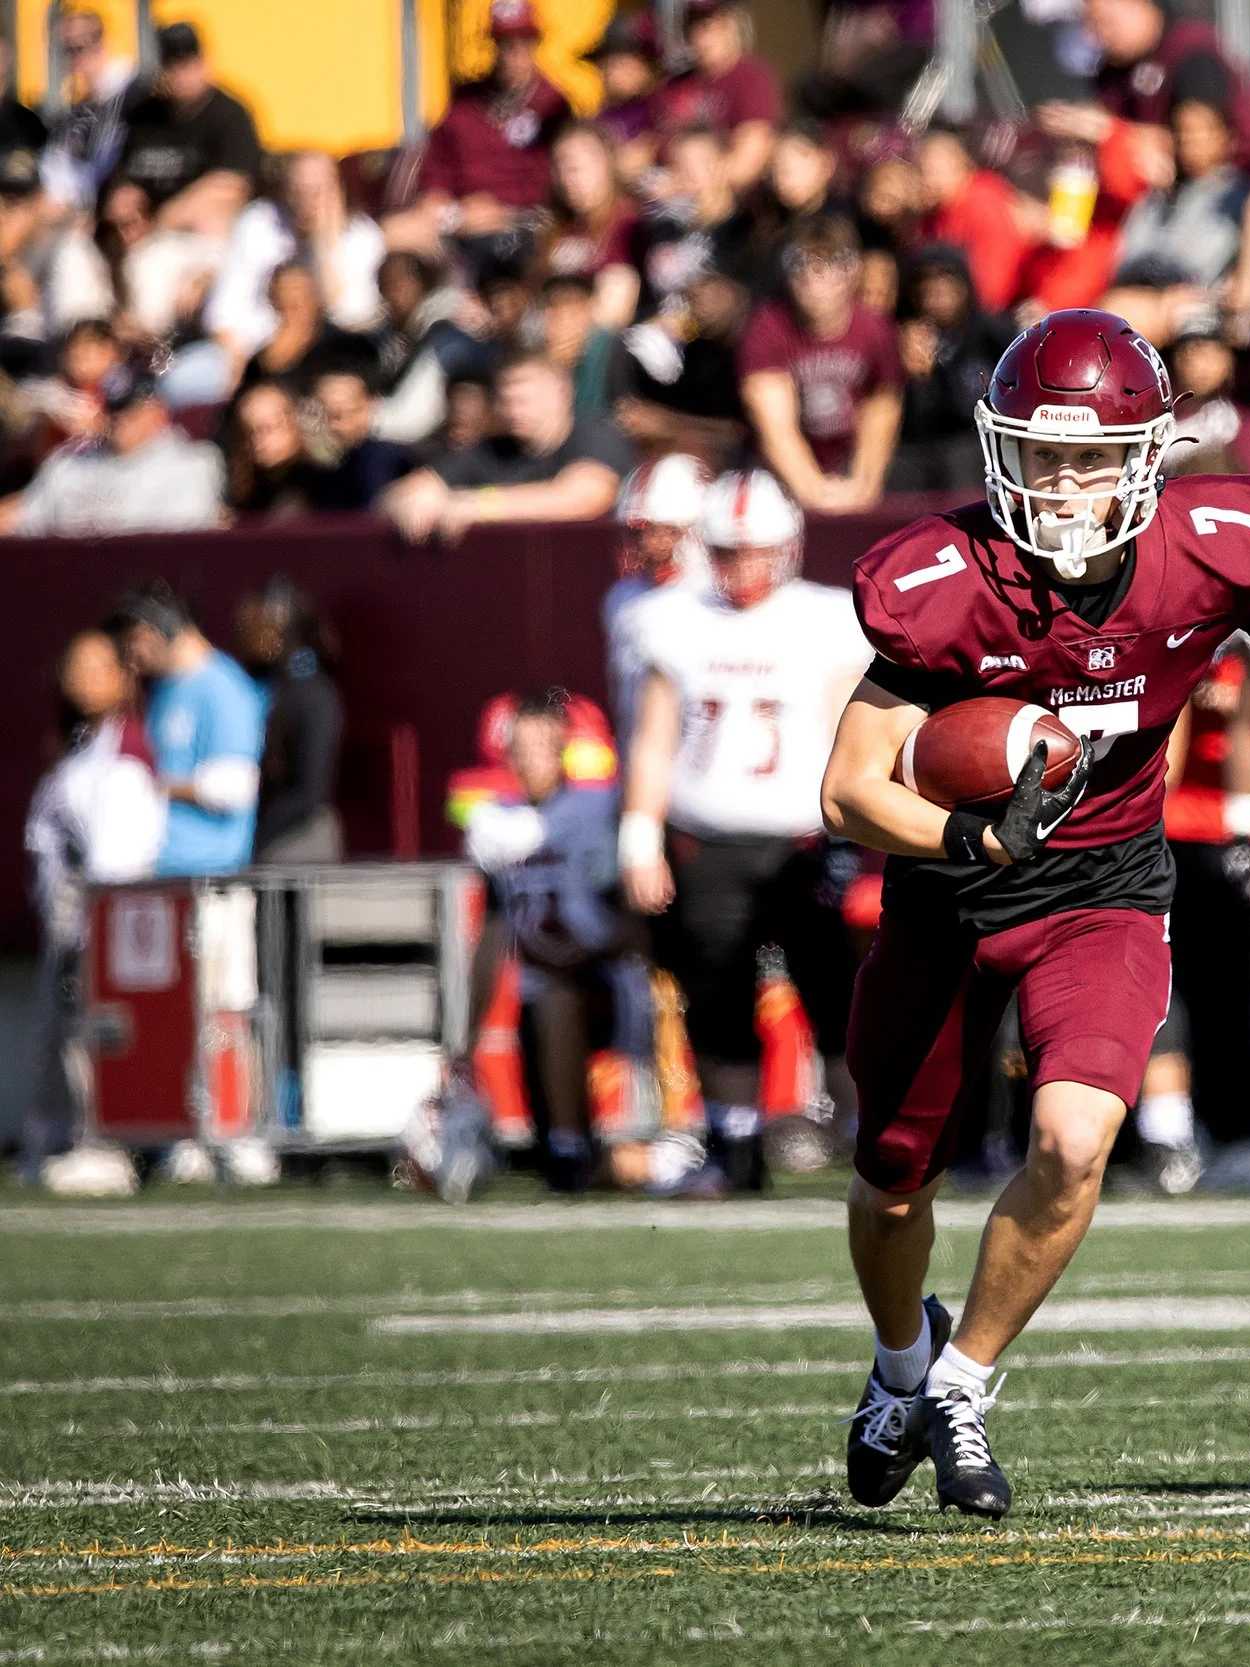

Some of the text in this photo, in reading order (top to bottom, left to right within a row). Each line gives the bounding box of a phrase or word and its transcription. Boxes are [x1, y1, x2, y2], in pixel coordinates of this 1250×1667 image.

[1040, 409, 1090, 422] Riddell
[893, 543, 968, 593] 7
[1050, 675, 1147, 706] McMASTER
[1058, 700, 1139, 764] 7
